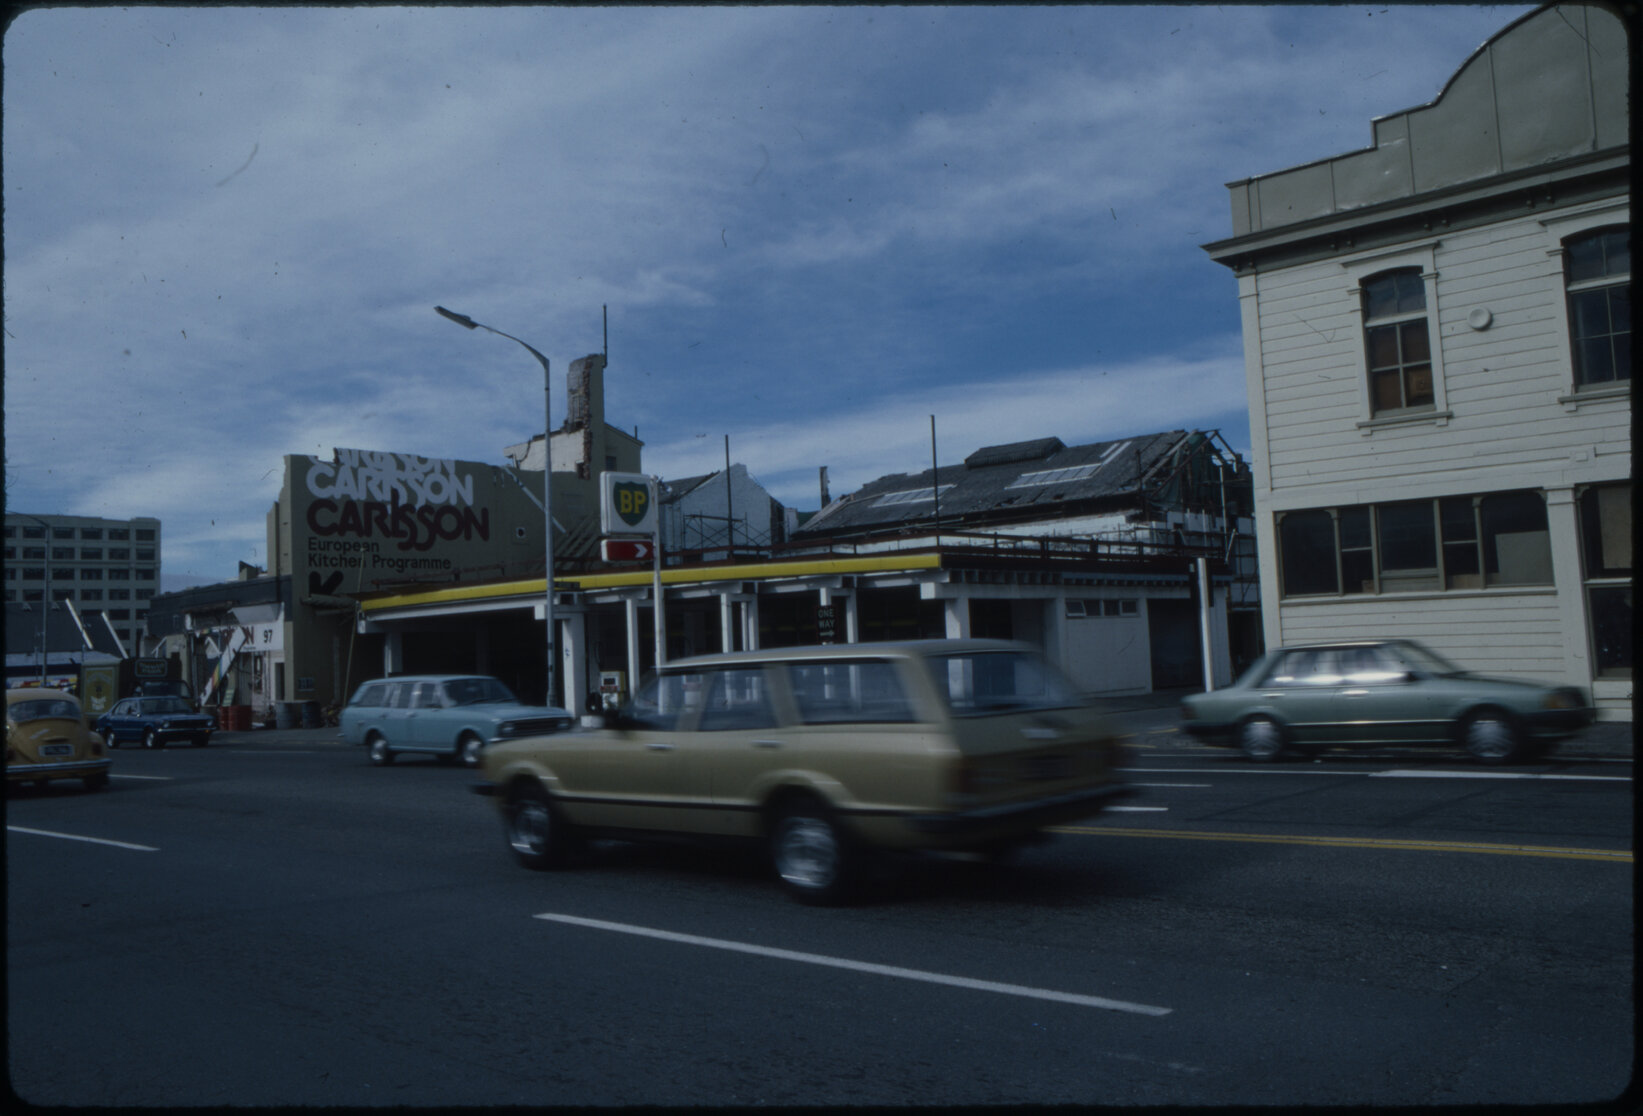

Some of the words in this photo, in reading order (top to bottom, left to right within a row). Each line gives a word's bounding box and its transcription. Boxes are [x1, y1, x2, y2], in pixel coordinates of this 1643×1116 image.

[619, 489, 647, 515] BP
[307, 488, 490, 551] CARLSSON
[308, 536, 380, 552] European
[308, 554, 367, 569] Kitchen
[372, 555, 451, 573] Programme
[817, 608, 835, 618] ONE
[817, 619, 835, 629] WAY
[264, 630, 272, 643] 97
